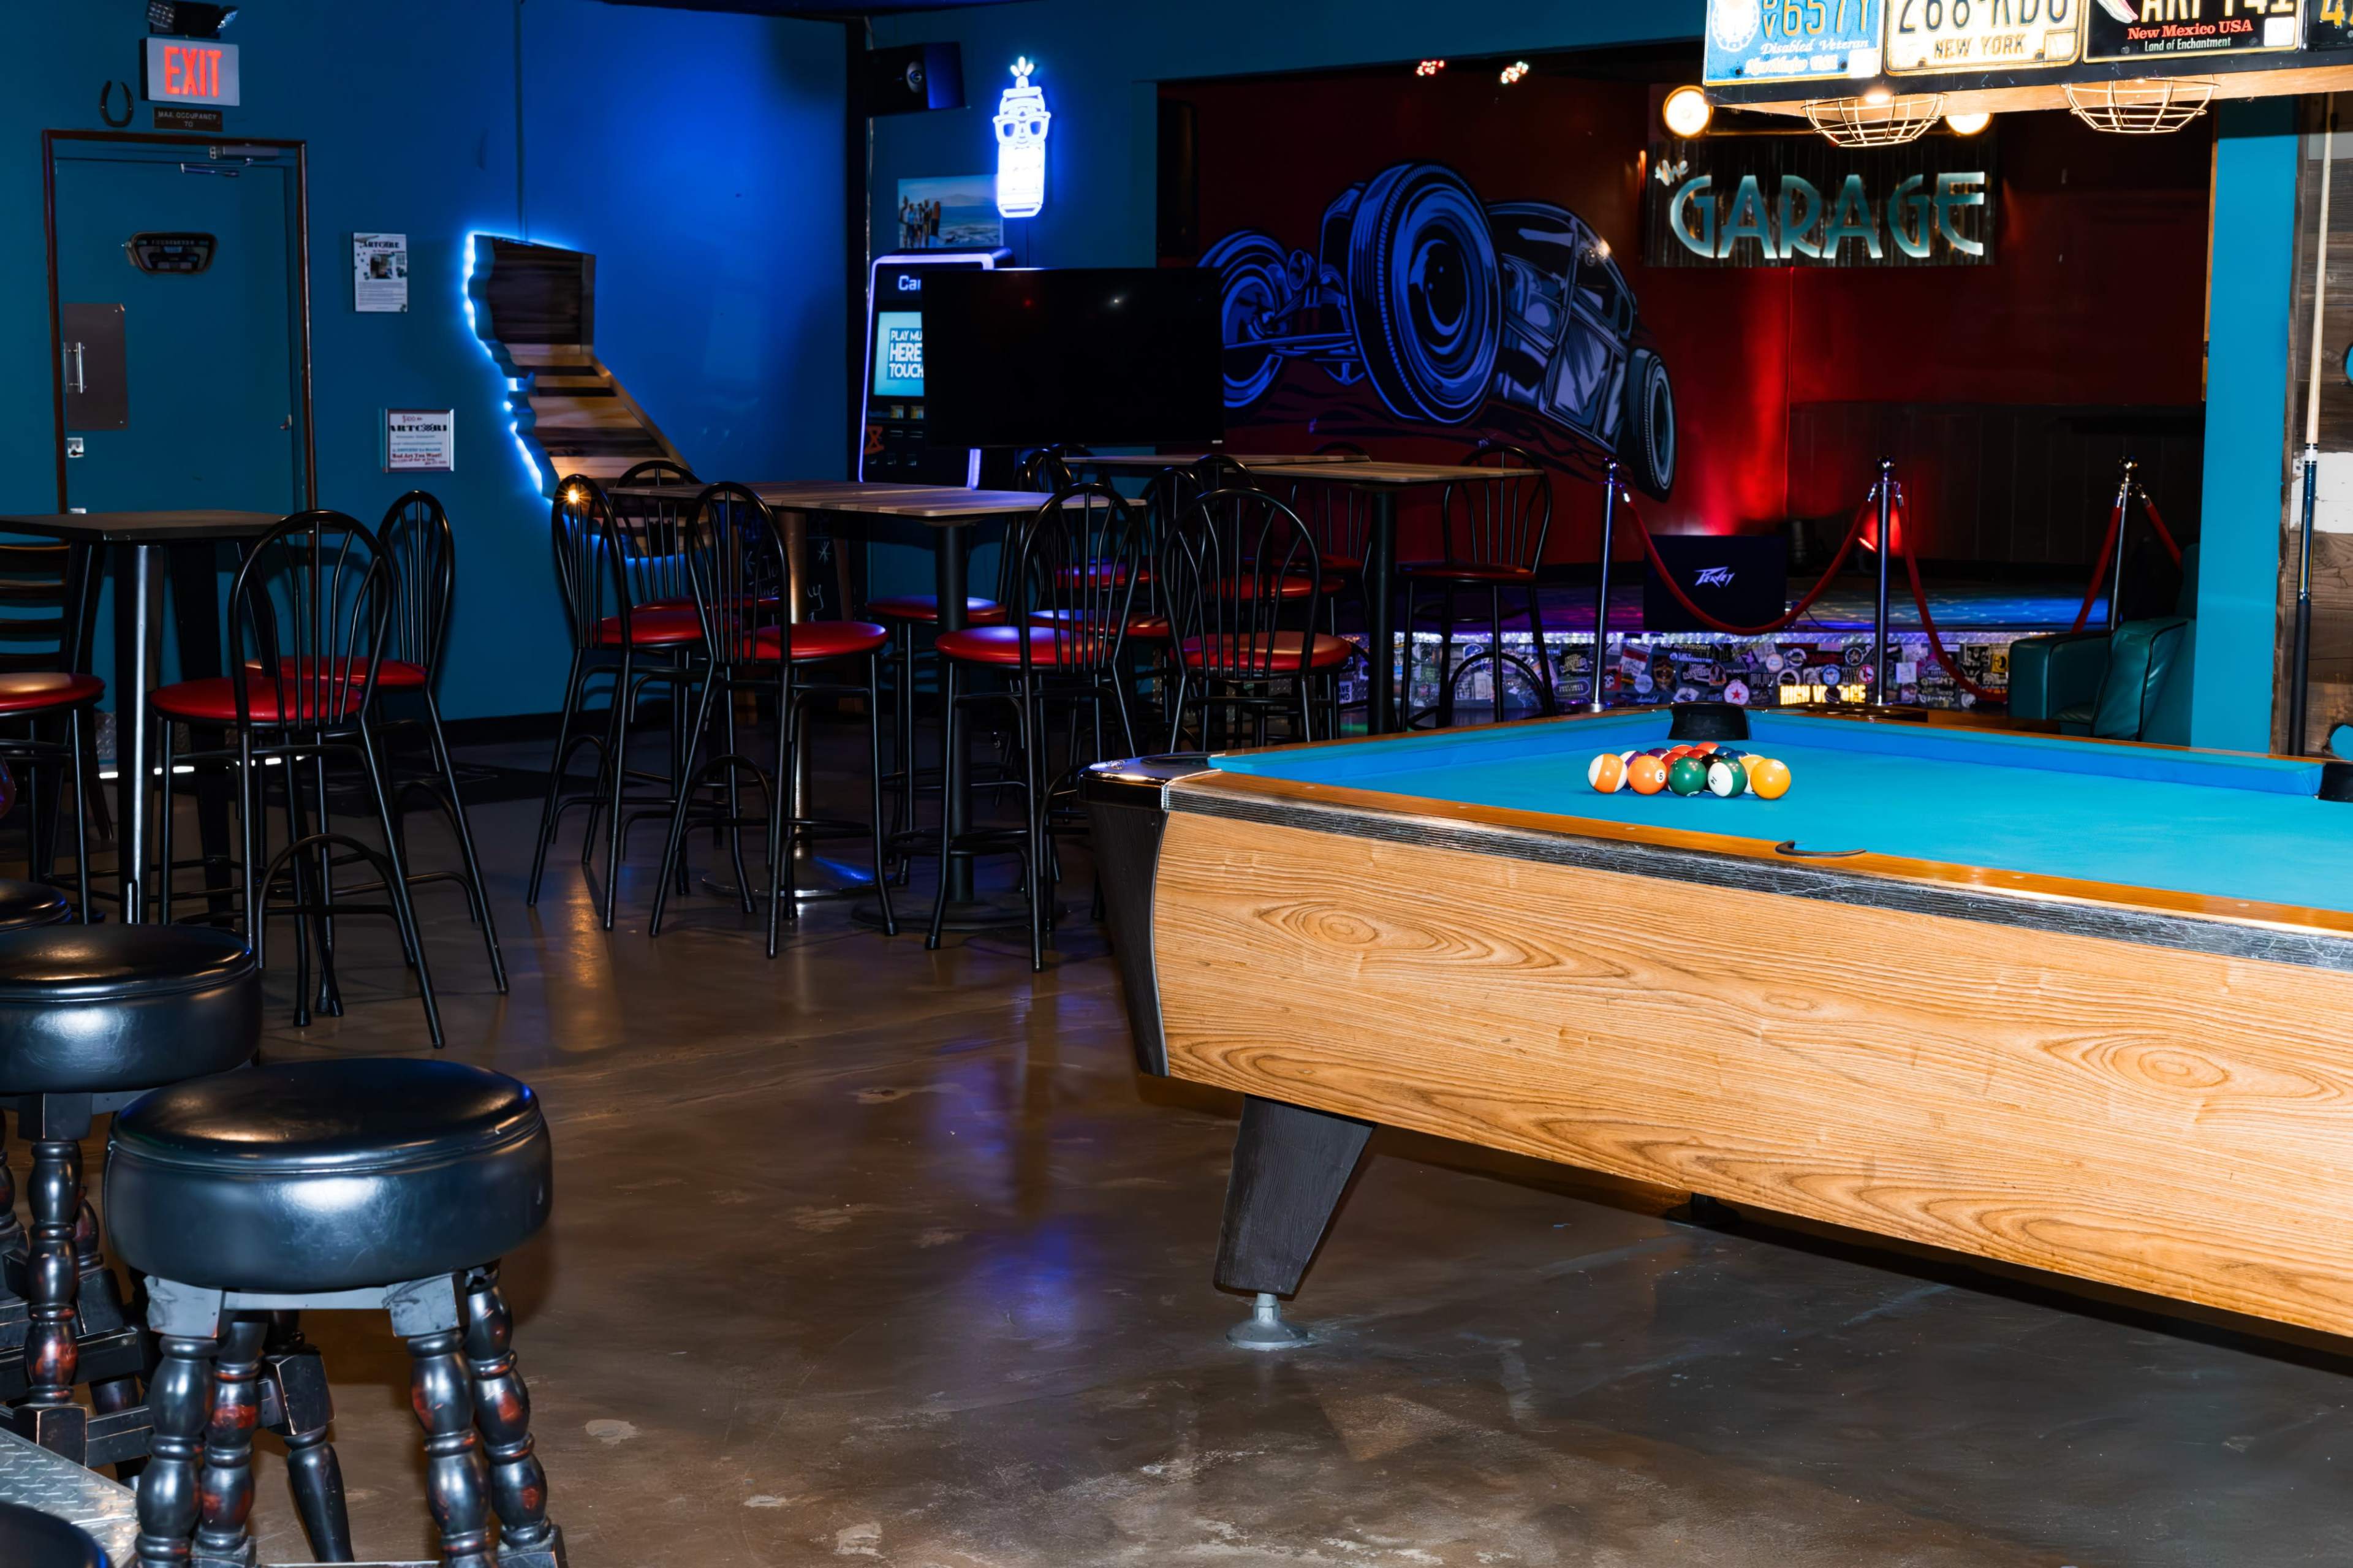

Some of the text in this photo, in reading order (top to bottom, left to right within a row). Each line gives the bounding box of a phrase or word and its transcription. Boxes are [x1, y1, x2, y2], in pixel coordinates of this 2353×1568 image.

[2127, 20, 2254, 40] New Mexico USA
[1760, 38, 1869, 55] Disabled Veteran
[1933, 33, 2026, 59] NEW YORK
[2145, 37, 2231, 51] Land of Enchantment
[164, 46, 222, 98] EXIT
[1670, 172, 1985, 259] GARAGE
[890, 330, 909, 341] PLAY
[889, 343, 922, 362] HERE
[889, 363, 923, 378] TOUCH
[1779, 684, 1811, 705] HIGH
[1659, 772, 1663, 781] 5
